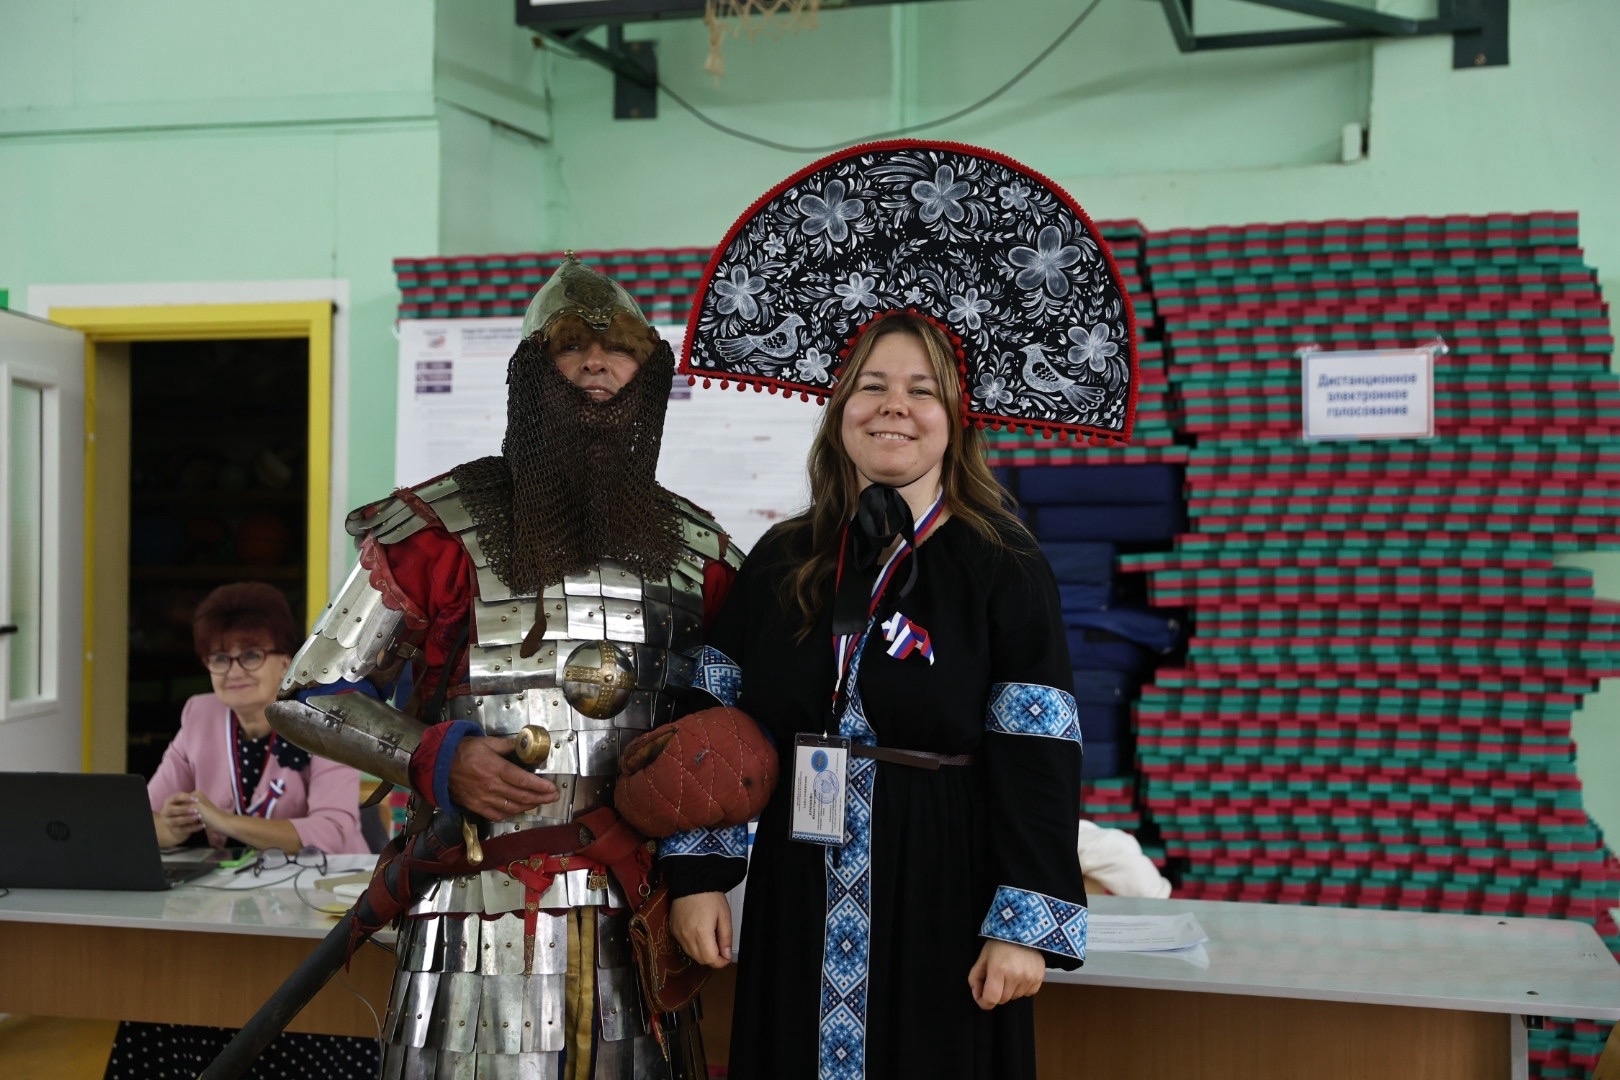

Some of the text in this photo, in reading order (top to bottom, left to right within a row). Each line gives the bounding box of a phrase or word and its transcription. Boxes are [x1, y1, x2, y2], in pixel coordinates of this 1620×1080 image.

[1318, 374, 1416, 388] Дистанционное
[1327, 390, 1407, 403] электронное
[1327, 406, 1407, 417] голосование
